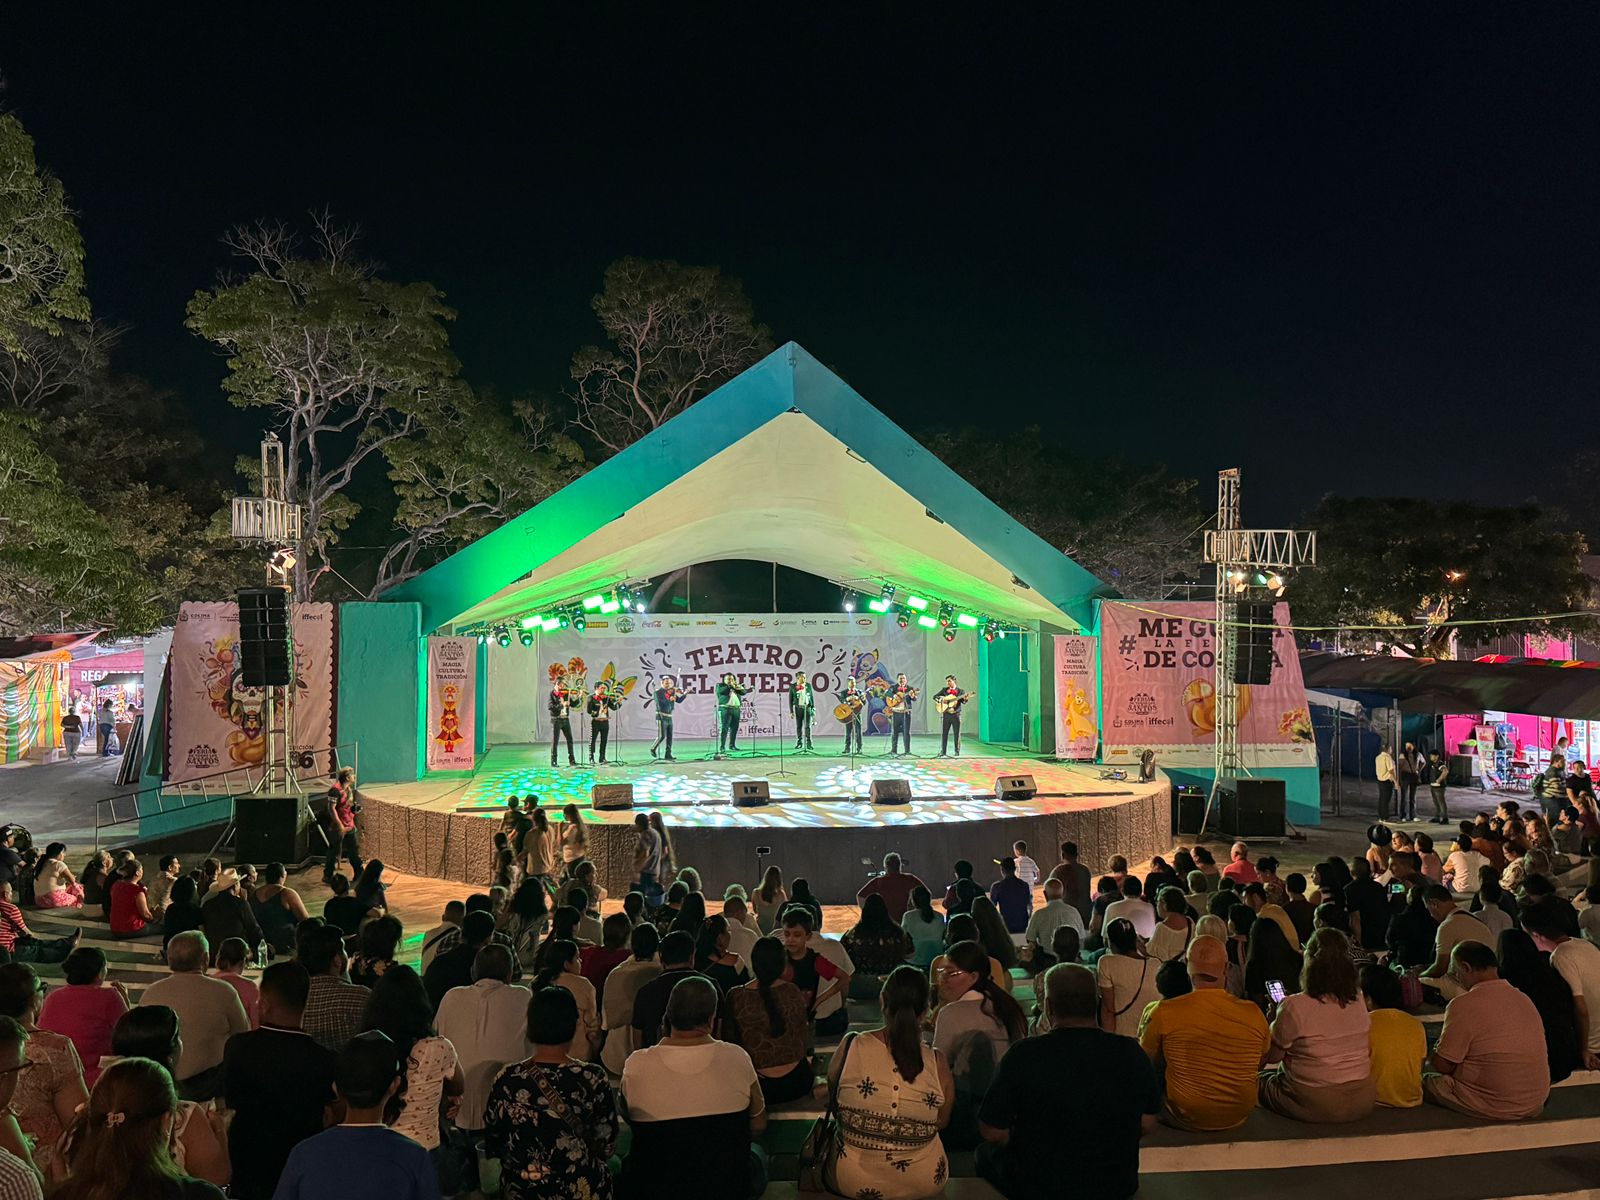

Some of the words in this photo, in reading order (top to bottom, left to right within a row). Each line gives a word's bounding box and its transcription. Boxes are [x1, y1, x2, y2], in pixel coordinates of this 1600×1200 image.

[1138, 618, 1183, 638] ME
[1155, 639, 1175, 648] LA
[685, 643, 804, 671] TEATRO
[1143, 650, 1177, 668] DE
[1182, 650, 1284, 668] COA
